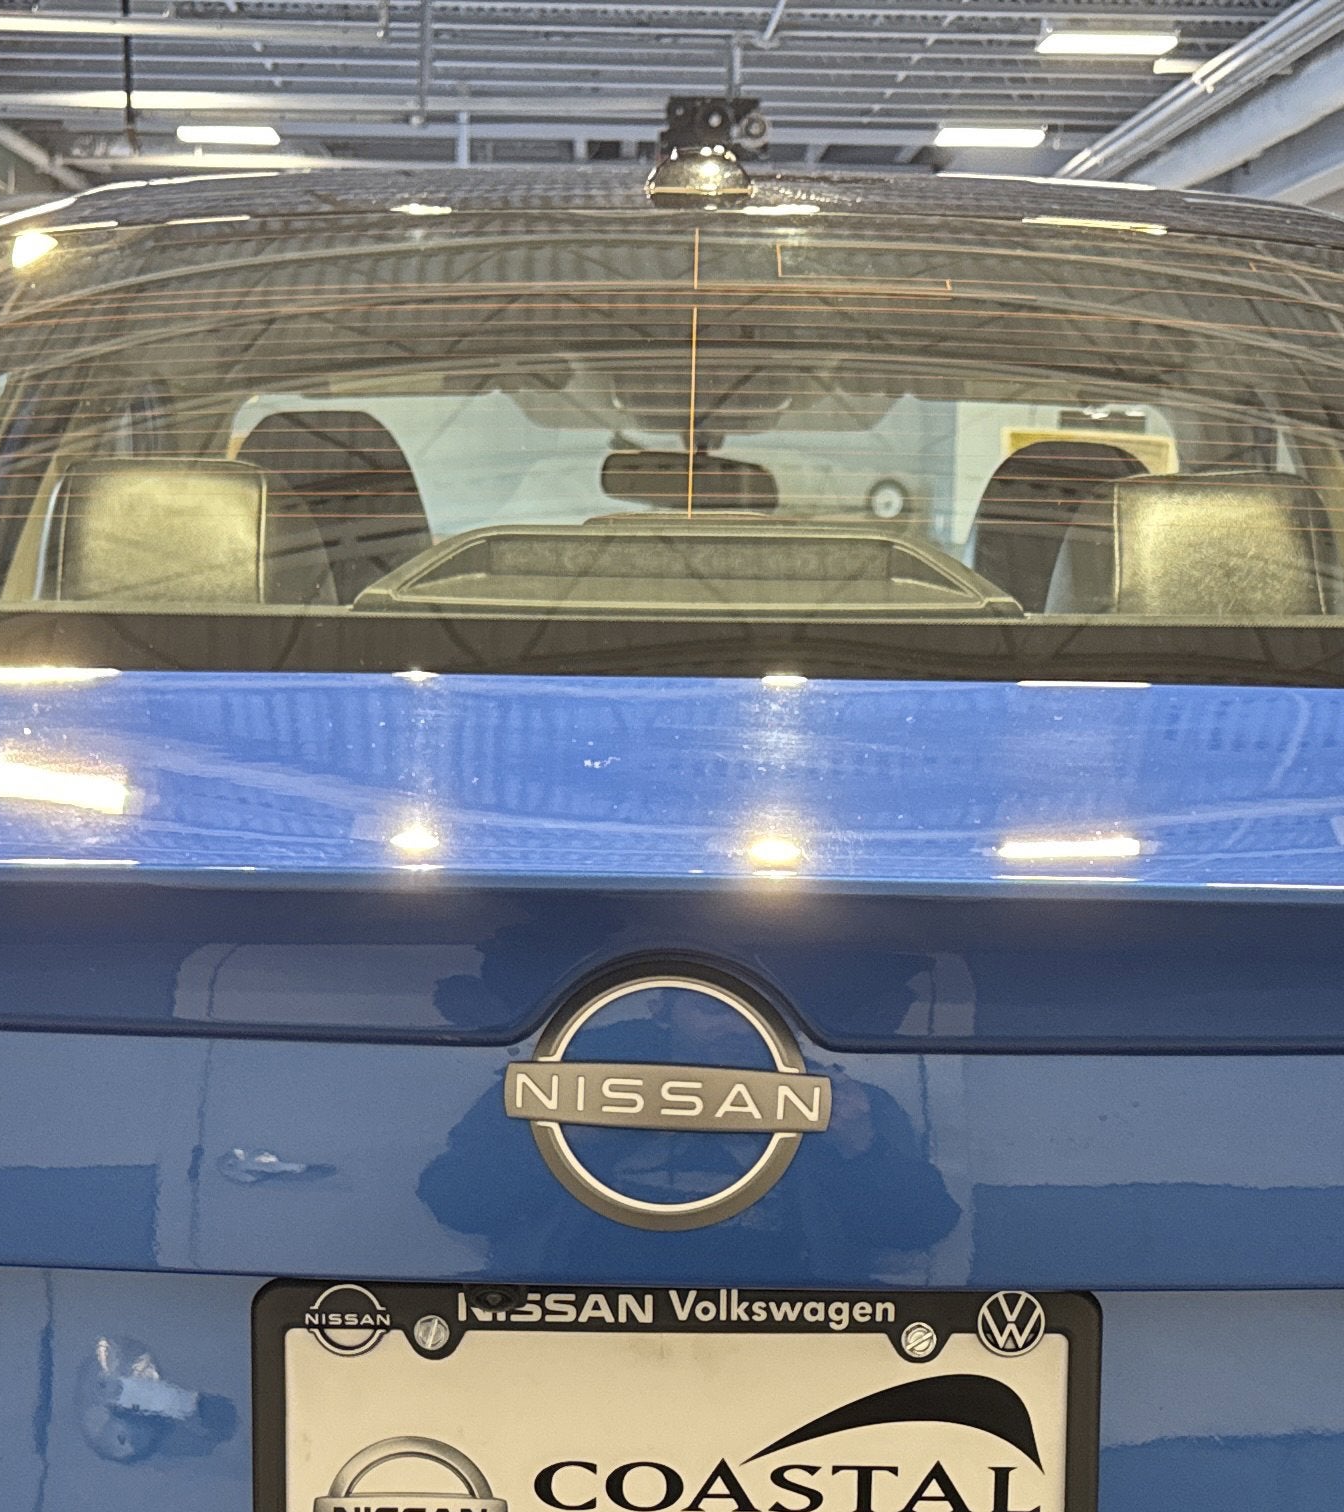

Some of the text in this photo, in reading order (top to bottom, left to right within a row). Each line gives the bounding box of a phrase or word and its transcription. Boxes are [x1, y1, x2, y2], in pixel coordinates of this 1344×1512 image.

[515, 1072, 821, 1122] NISSAN
[304, 1312, 391, 1327] NISSAN
[668, 1288, 896, 1331] Volkswagen
